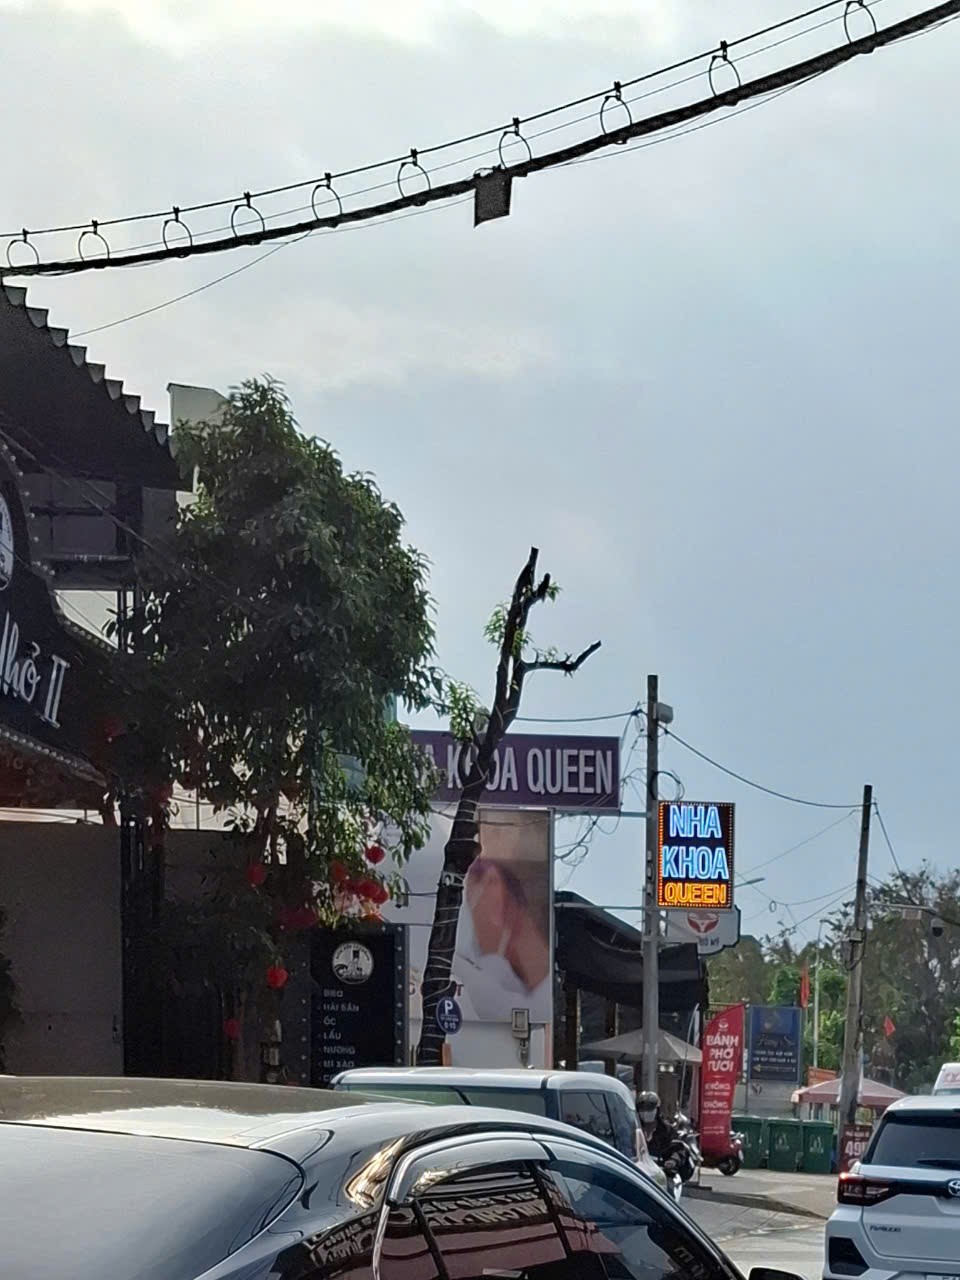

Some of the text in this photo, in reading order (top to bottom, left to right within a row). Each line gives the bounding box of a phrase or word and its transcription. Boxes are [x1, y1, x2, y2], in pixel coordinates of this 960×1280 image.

[527, 748, 613, 795] QUEEN
[669, 804, 723, 839] NHA
[661, 845, 730, 880] KHOA
[664, 882, 727, 905] QUEEN
[706, 1031, 739, 1047] BÁNH
[710, 1046, 734, 1060] PHỞ
